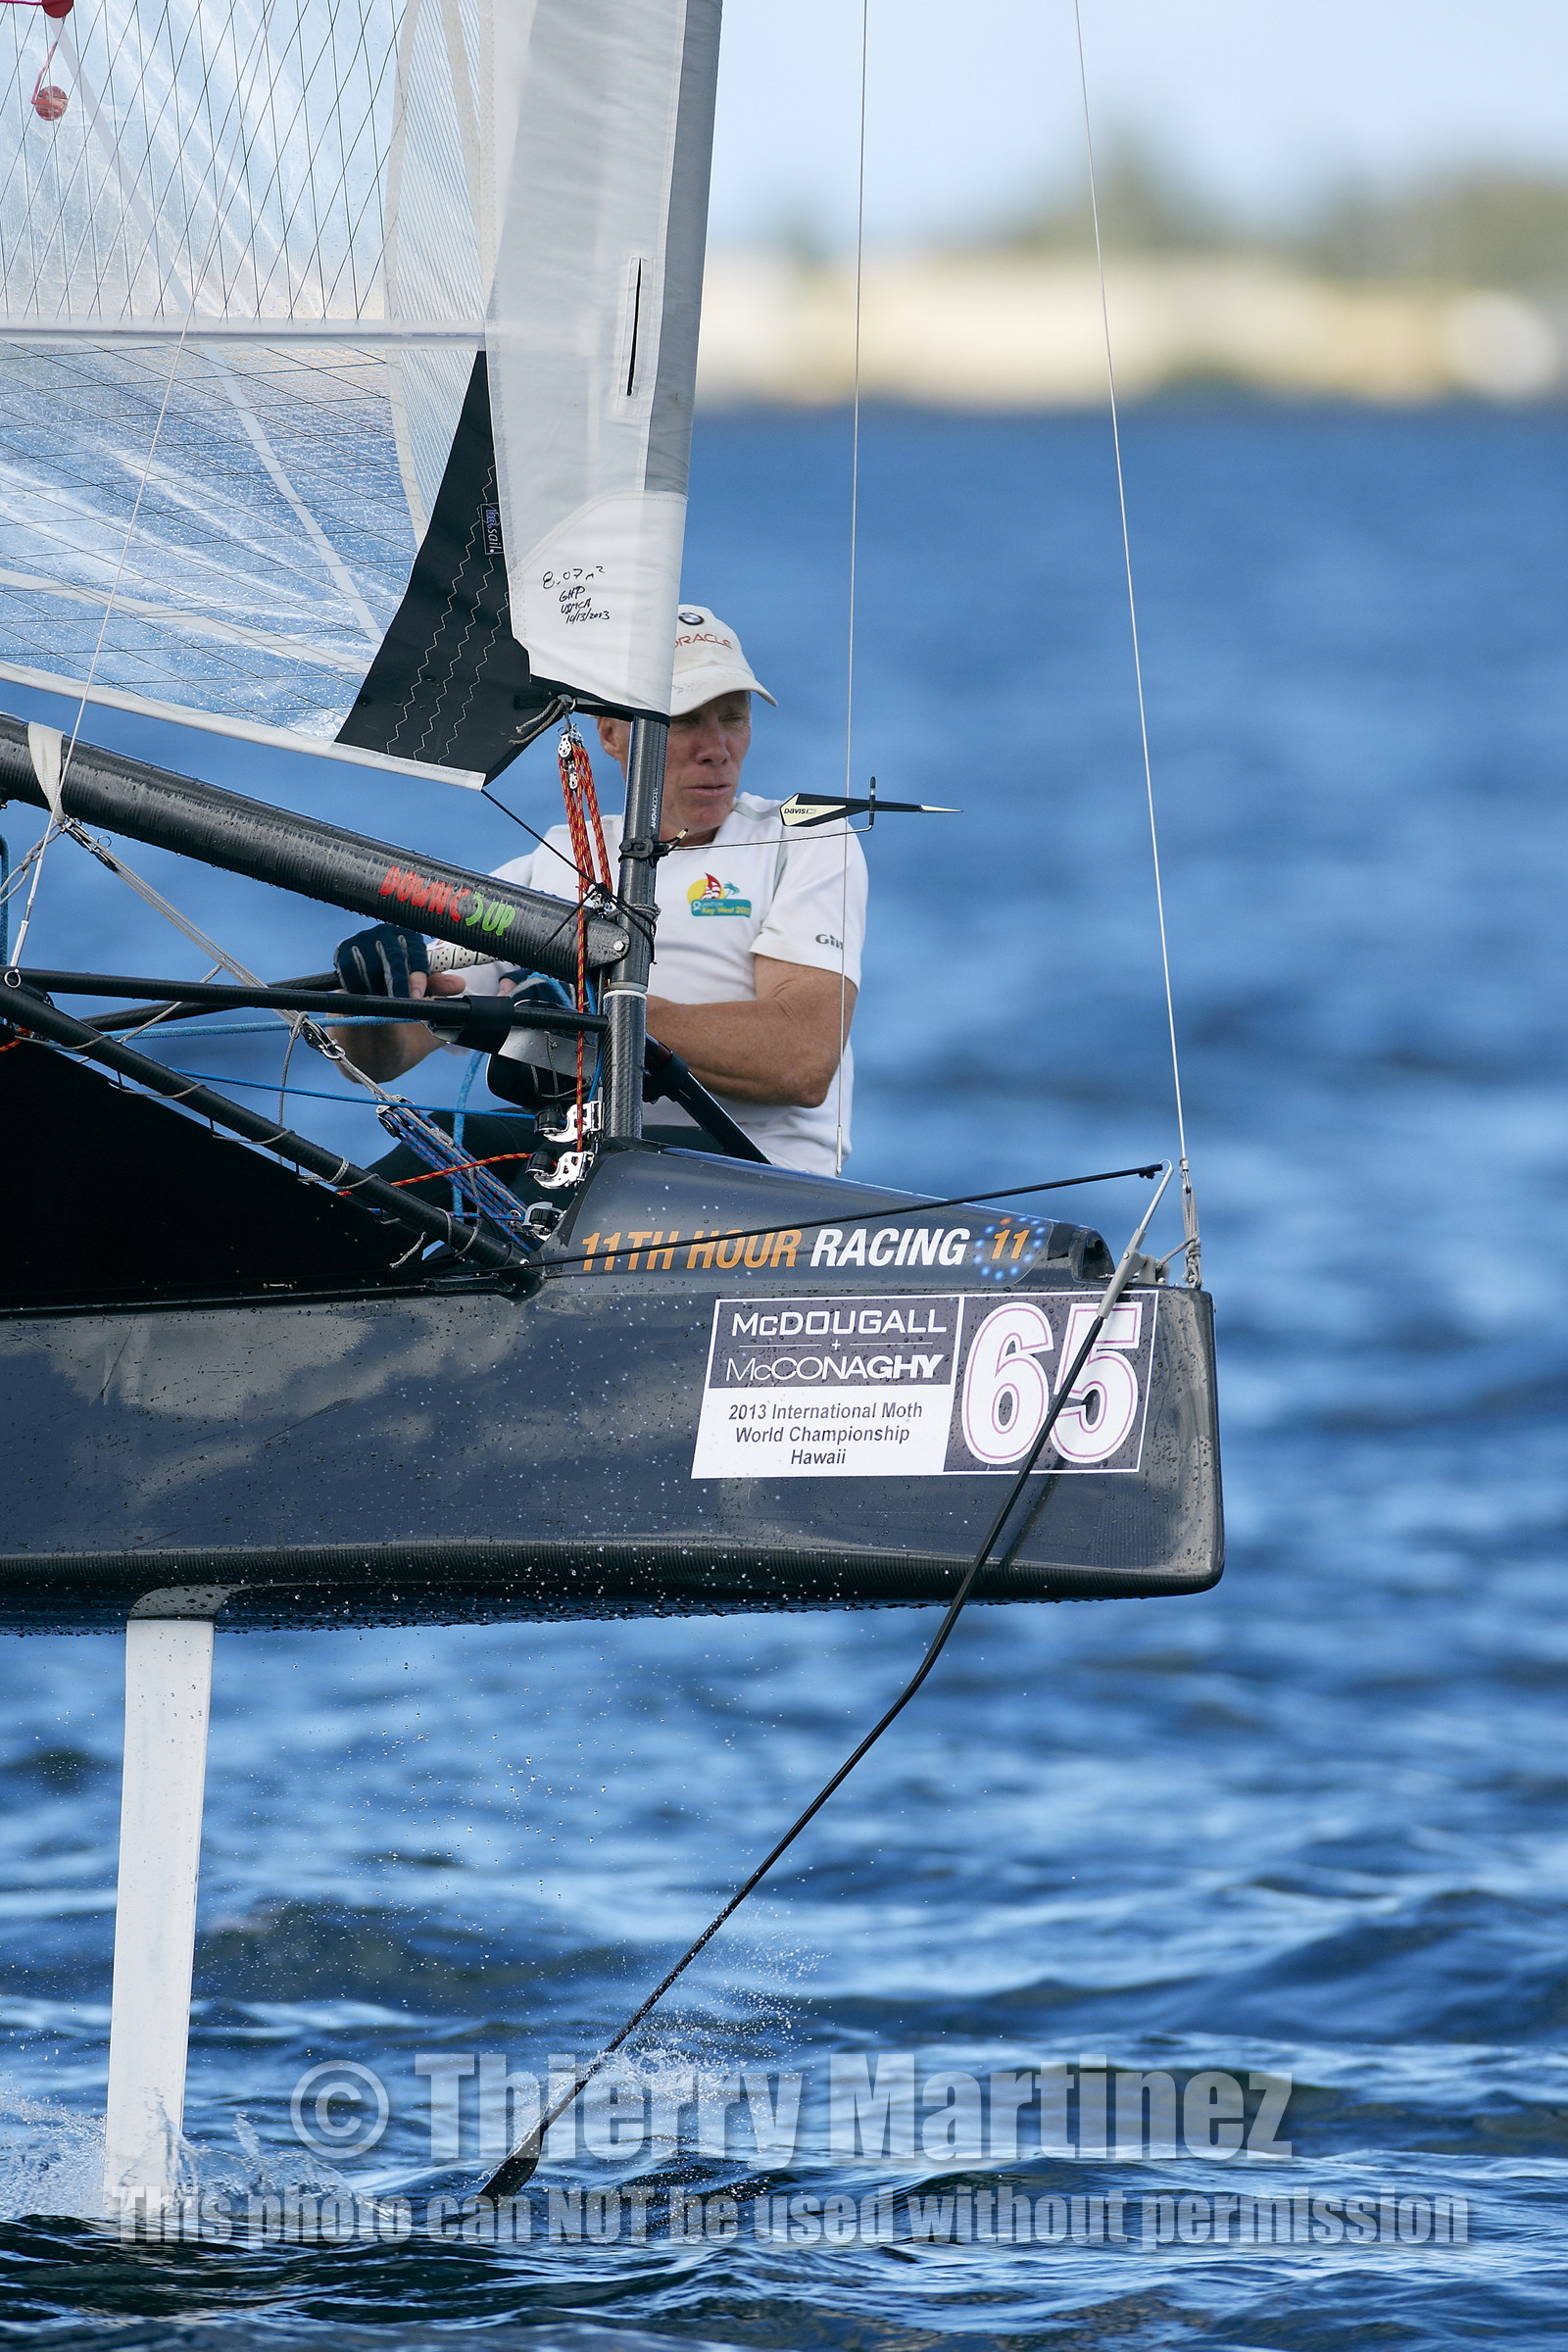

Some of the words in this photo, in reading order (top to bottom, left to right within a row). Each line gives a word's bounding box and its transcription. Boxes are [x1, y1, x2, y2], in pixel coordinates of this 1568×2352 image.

[379, 865, 453, 914] DOWN
[481, 901, 516, 936] UP
[581, 1230, 679, 1271] 11TH
[686, 1229, 803, 1270] HOUR
[809, 1227, 971, 1268] RACING
[991, 1229, 1030, 1260] 11
[731, 1308, 948, 1337] McDOUGALL
[725, 1353, 945, 1382] McCONAGHY
[961, 1301, 1144, 1465] 65
[728, 1403, 767, 1421] 2013
[771, 1402, 877, 1420] International
[881, 1401, 923, 1418] Moth
[735, 1427, 784, 1443] World
[788, 1425, 910, 1446] Championship
[790, 1448, 847, 1465] Hawaii
